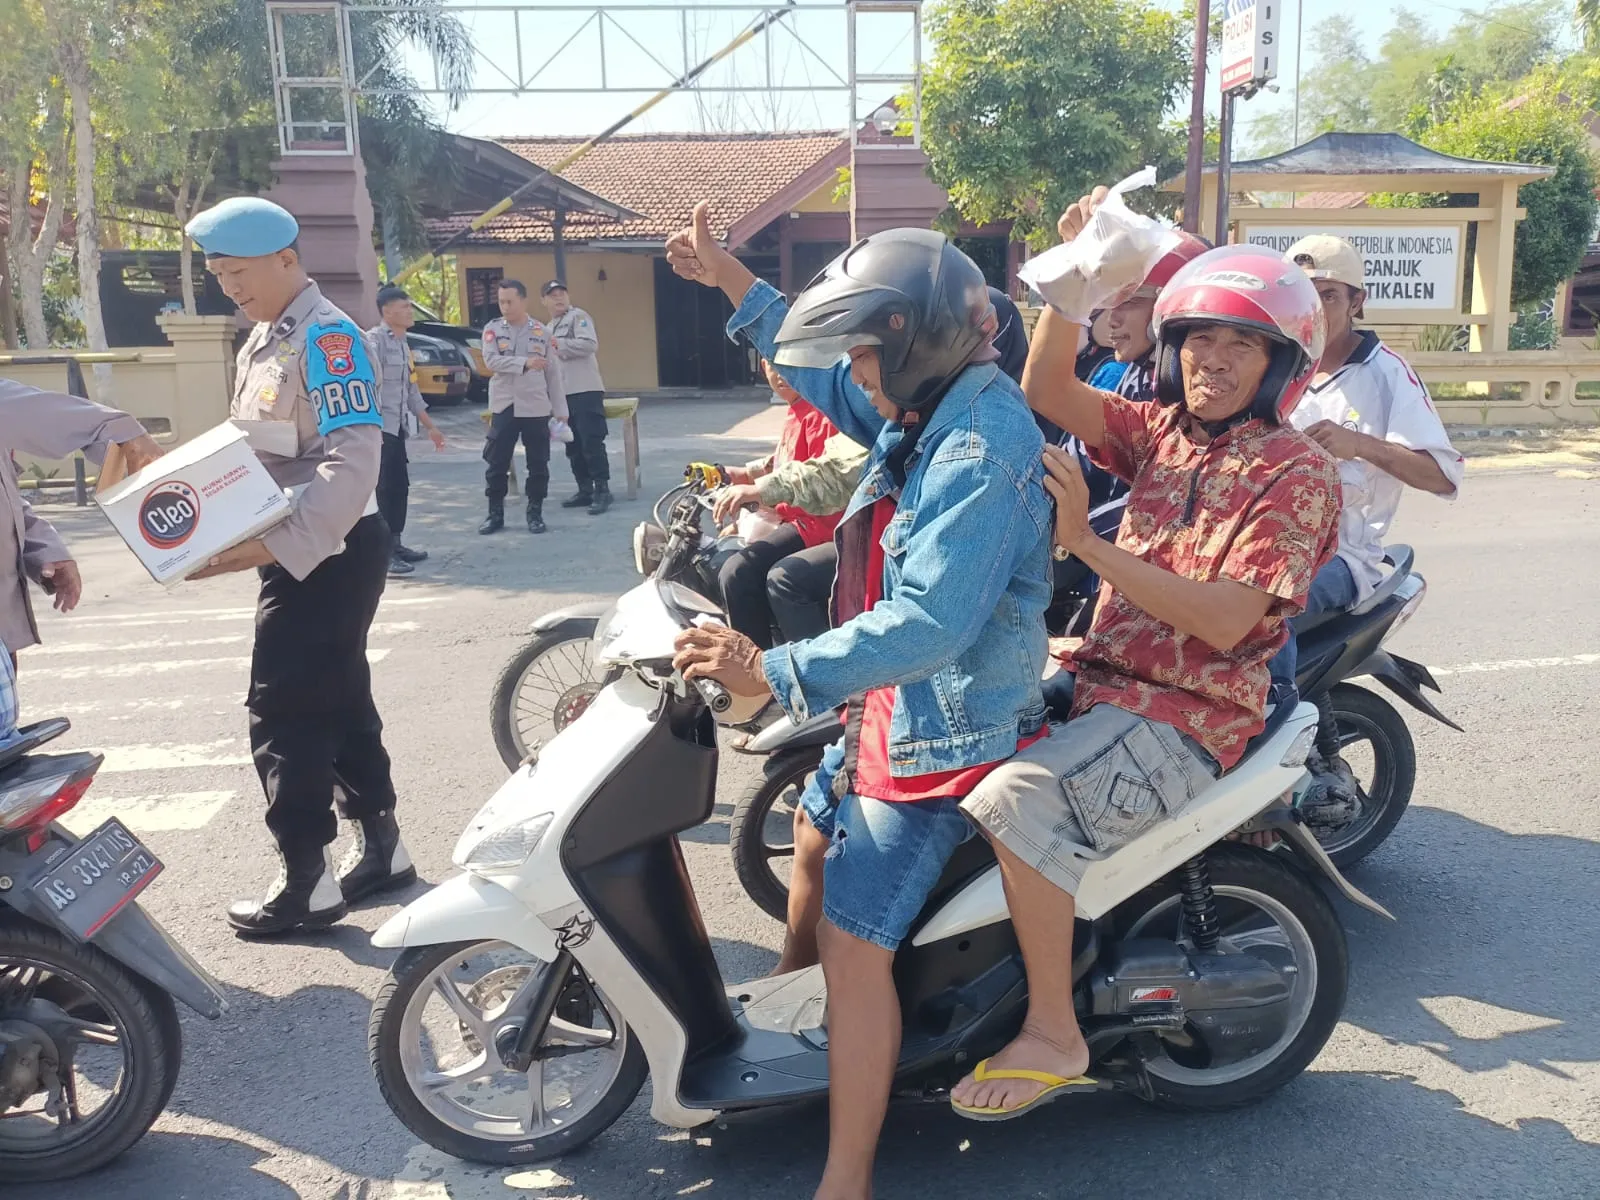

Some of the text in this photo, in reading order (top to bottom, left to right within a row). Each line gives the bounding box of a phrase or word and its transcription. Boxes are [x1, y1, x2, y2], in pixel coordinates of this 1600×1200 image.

[1225, 12, 1253, 40] POLISI
[1249, 236, 1303, 252] EPOLISIA
[1398, 237, 1453, 254] INDONESIA
[1363, 259, 1422, 277] GANJUK
[1362, 282, 1434, 299] TIKALEN
[147, 499, 194, 534] Cleo
[44, 879, 77, 910] AG
[72, 844, 116, 886] 3347
